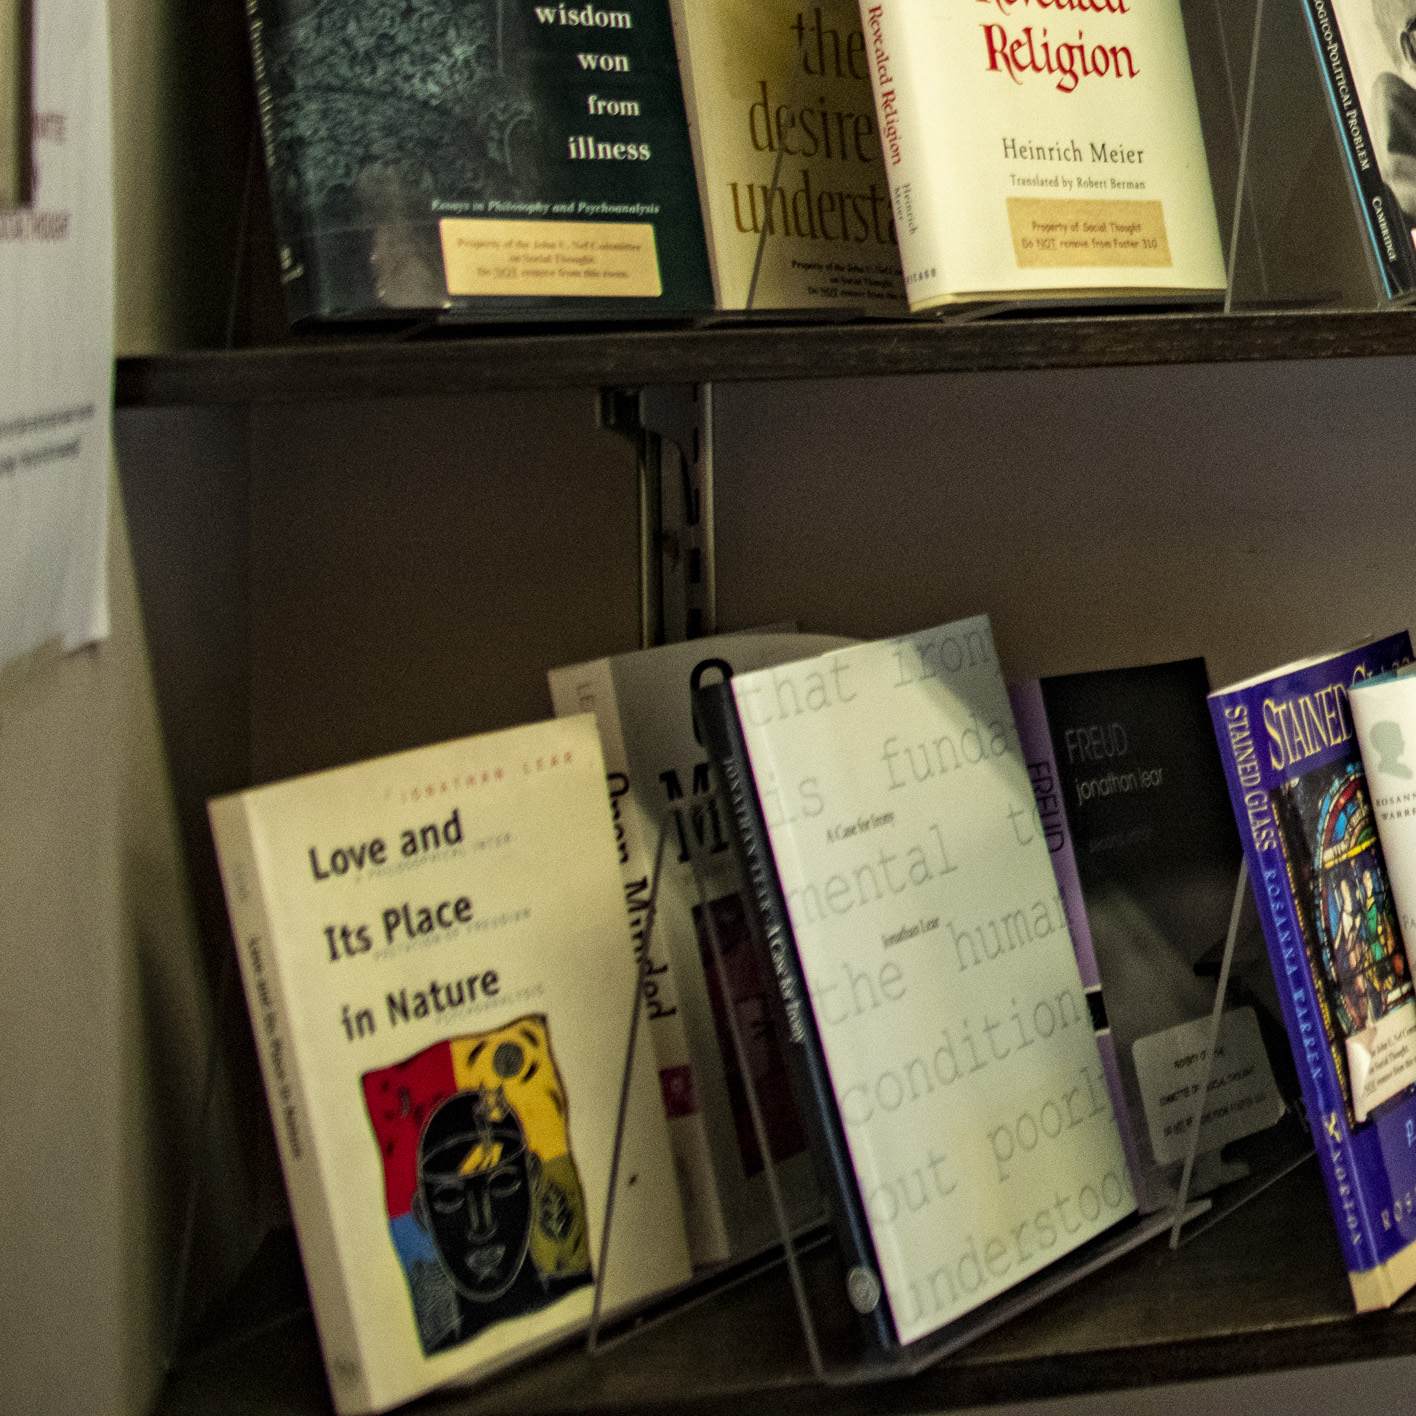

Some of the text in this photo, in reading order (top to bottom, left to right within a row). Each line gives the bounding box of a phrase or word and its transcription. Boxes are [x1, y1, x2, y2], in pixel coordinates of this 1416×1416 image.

[535, 1, 633, 30] wisdom
[577, 50, 630, 74] won
[978, 21, 1141, 94] Religion
[587, 94, 641, 117] from
[568, 134, 652, 163] illness
[1225, 704, 1275, 853] STAINED GLASS
[308, 809, 464, 884] Love and
[323, 893, 475, 965] Its Place
[341, 965, 501, 1044] in Nature
